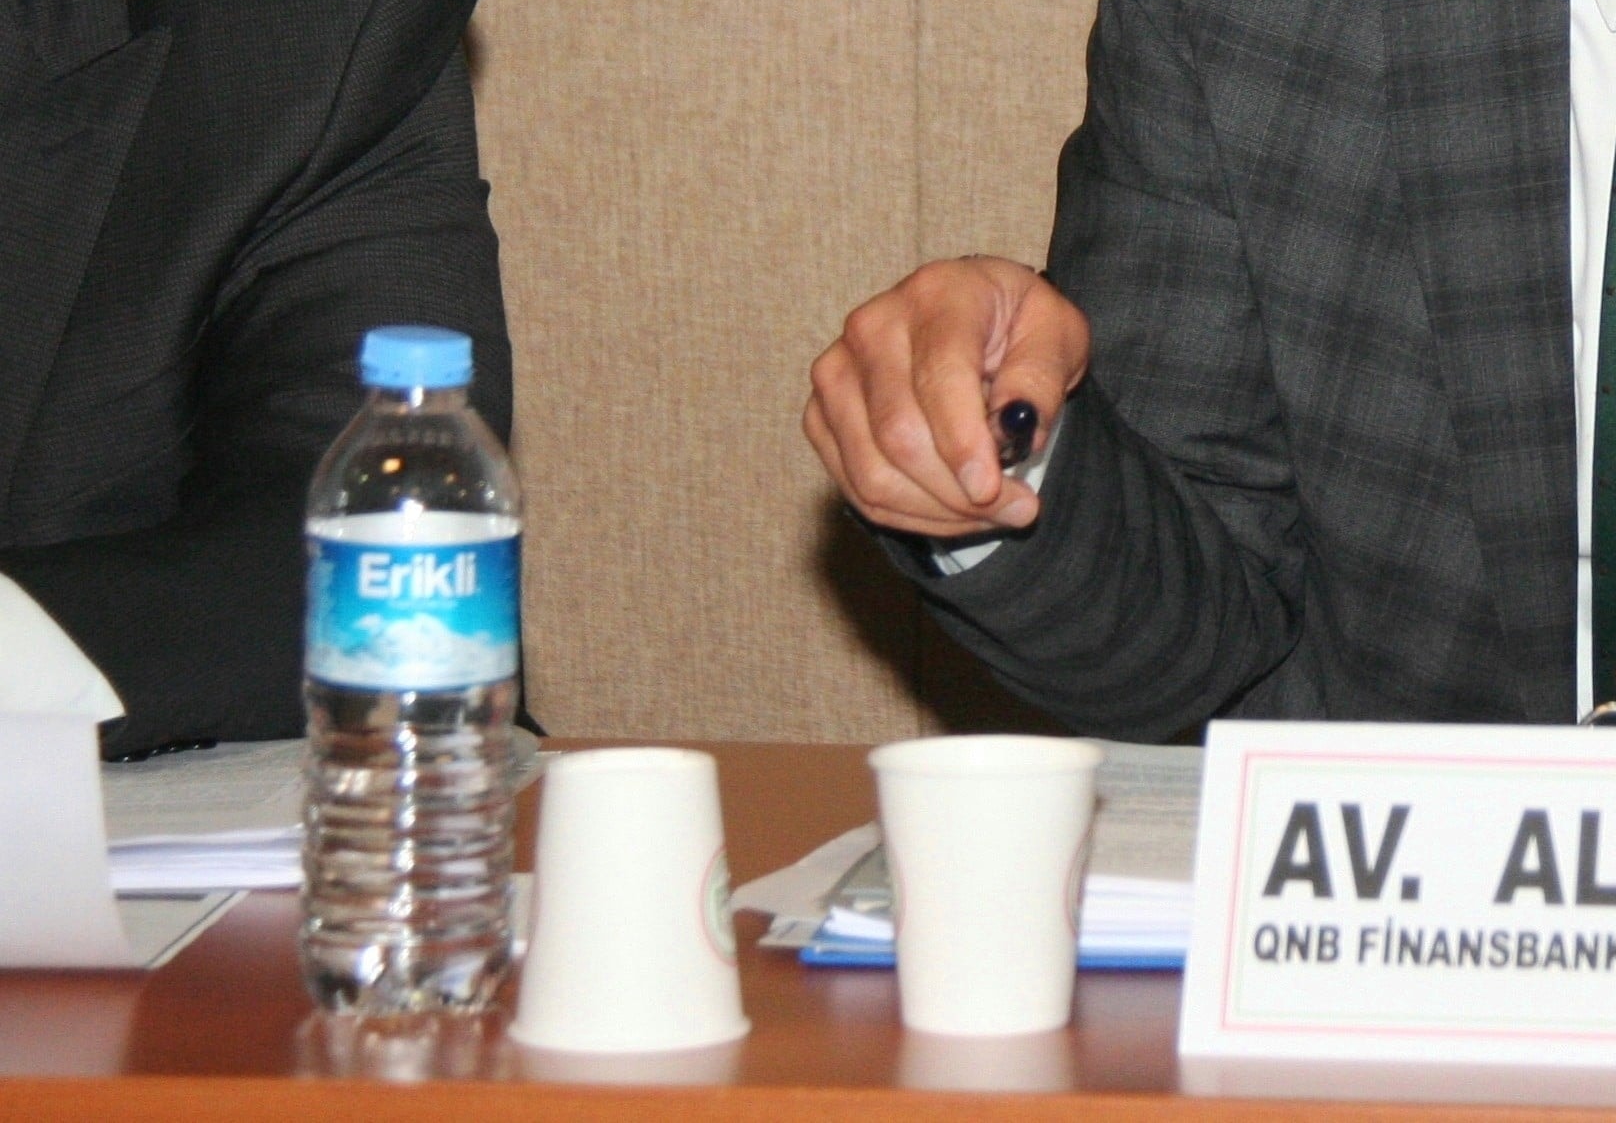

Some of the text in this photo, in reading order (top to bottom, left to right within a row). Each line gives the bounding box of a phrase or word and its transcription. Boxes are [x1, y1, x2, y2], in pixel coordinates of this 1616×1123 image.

[358, 552, 477, 598] Erikli
[1262, 802, 1420, 901] AV.
[1253, 924, 1341, 962] QNB
